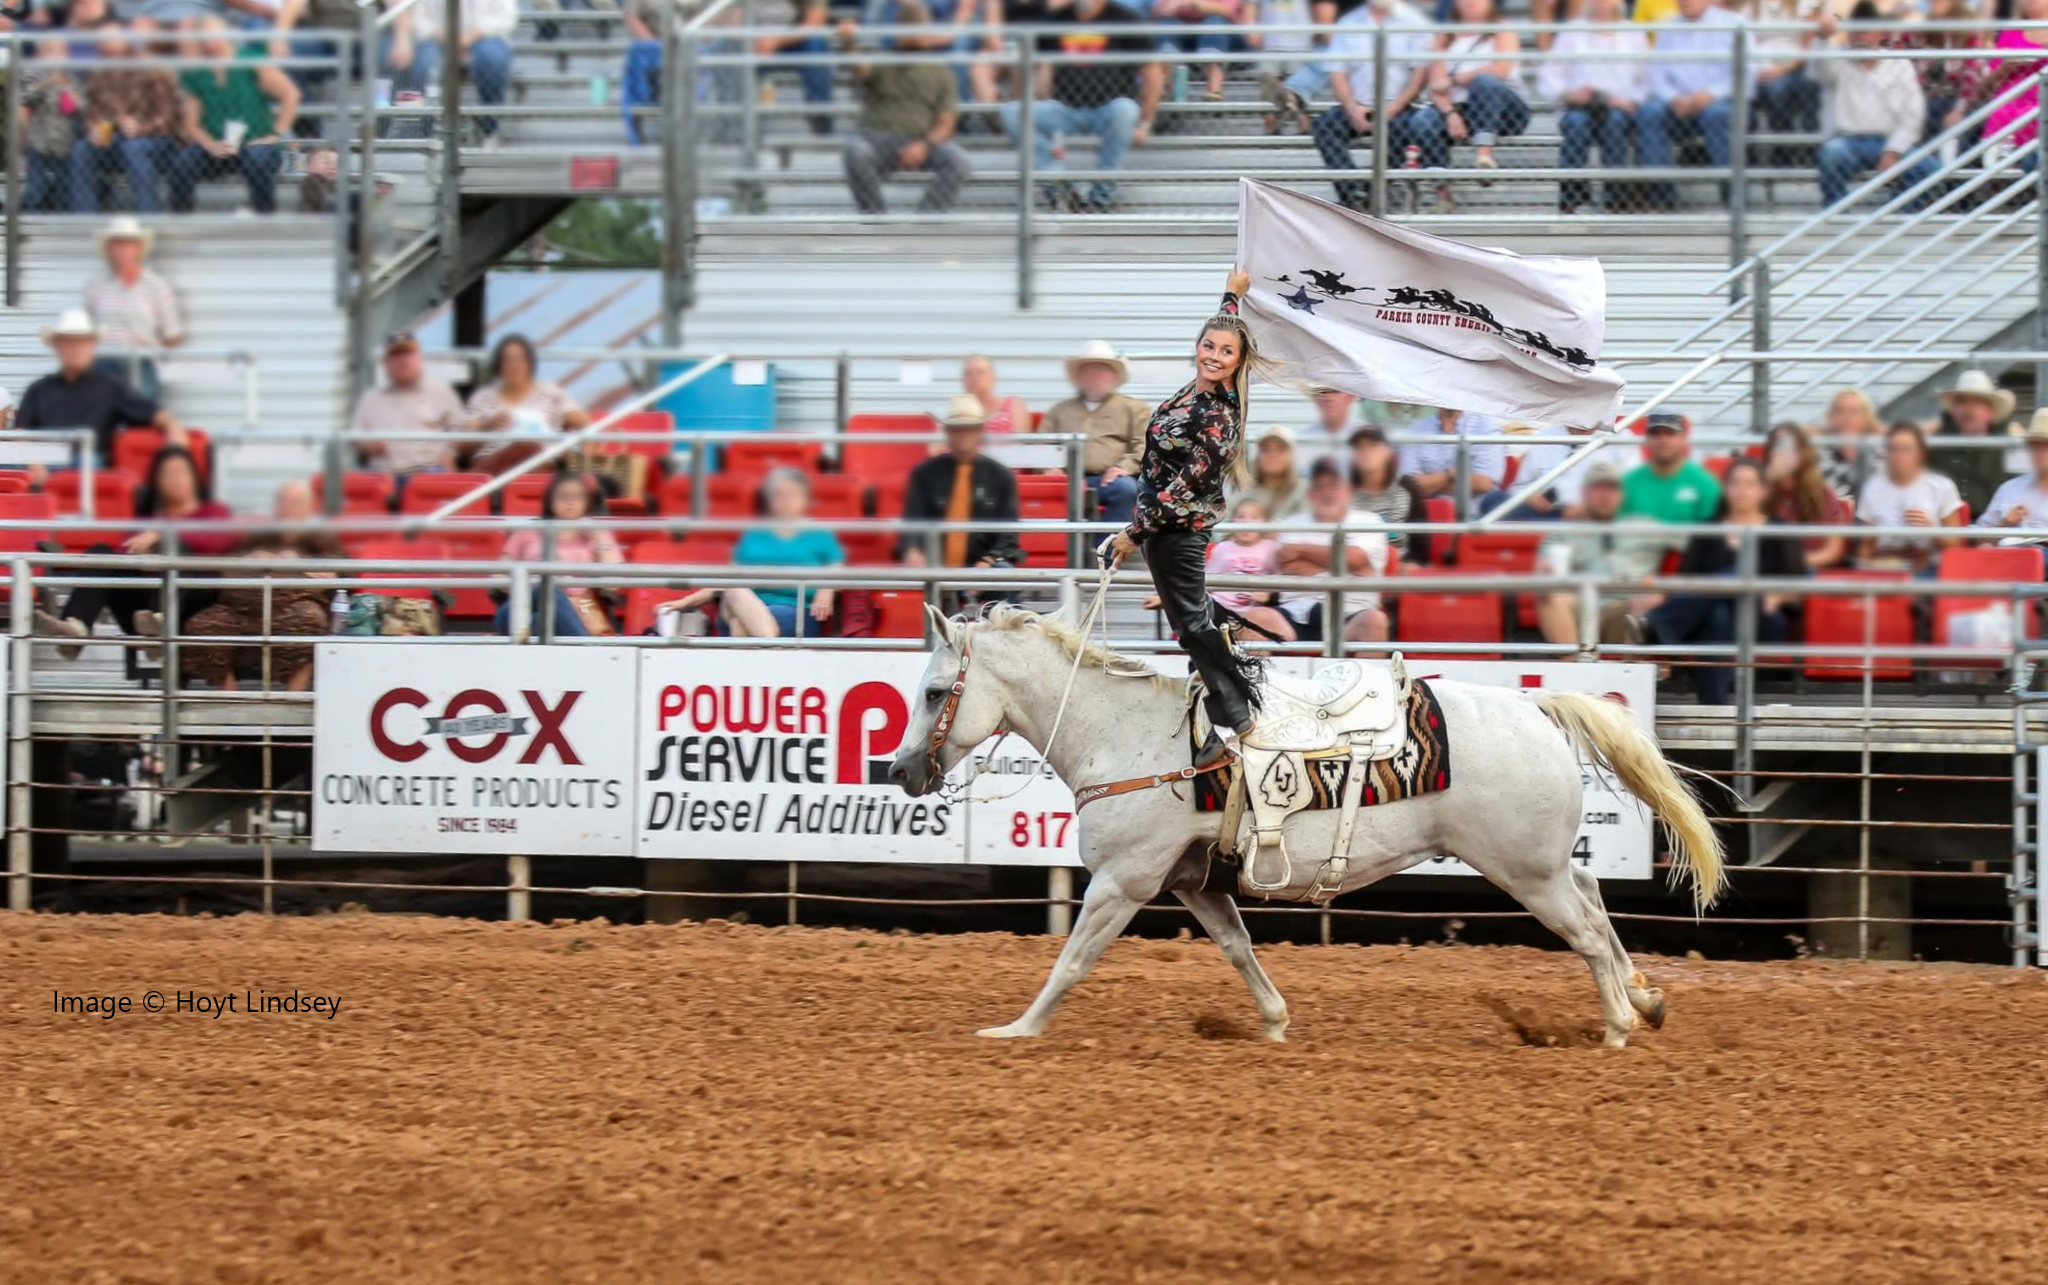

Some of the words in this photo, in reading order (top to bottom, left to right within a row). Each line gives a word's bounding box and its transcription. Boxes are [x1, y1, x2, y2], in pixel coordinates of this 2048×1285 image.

[1375, 309, 1412, 323] PARKER
[1416, 311, 1451, 327] COUNTY
[370, 687, 586, 765] COX
[659, 684, 827, 734] POWER
[645, 735, 827, 783] SERVICE
[323, 774, 457, 806] CONCRETE
[473, 776, 621, 809] PRODUCTS
[437, 817, 480, 832] SINCE
[645, 792, 767, 831] Diesel
[775, 794, 951, 836] Additives
